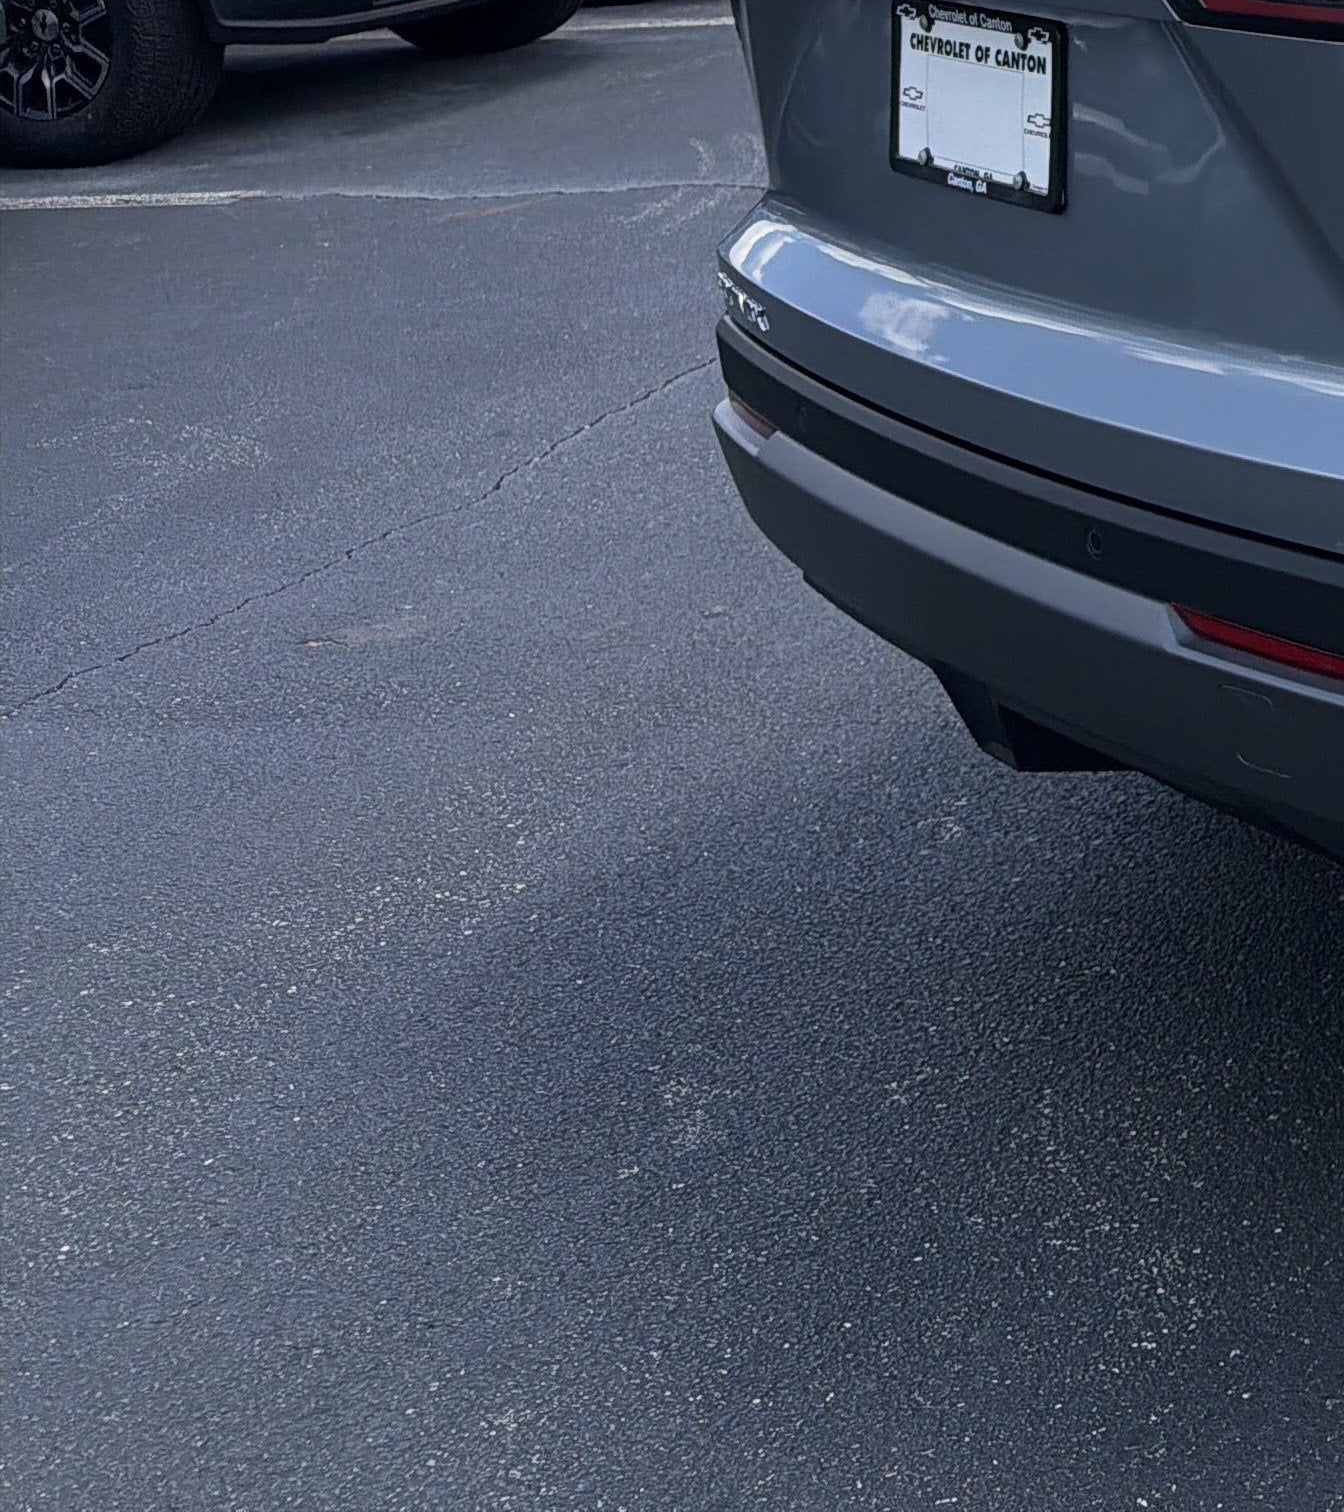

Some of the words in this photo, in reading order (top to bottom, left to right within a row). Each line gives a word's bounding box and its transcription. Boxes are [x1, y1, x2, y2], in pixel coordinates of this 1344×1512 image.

[928, 3, 968, 27] Chevrolet
[969, 12, 979, 26] of
[980, 13, 1013, 32] Canton
[910, 33, 971, 61] CHEVROLET
[975, 45, 991, 64] OF
[995, 49, 1047, 75] CANTON
